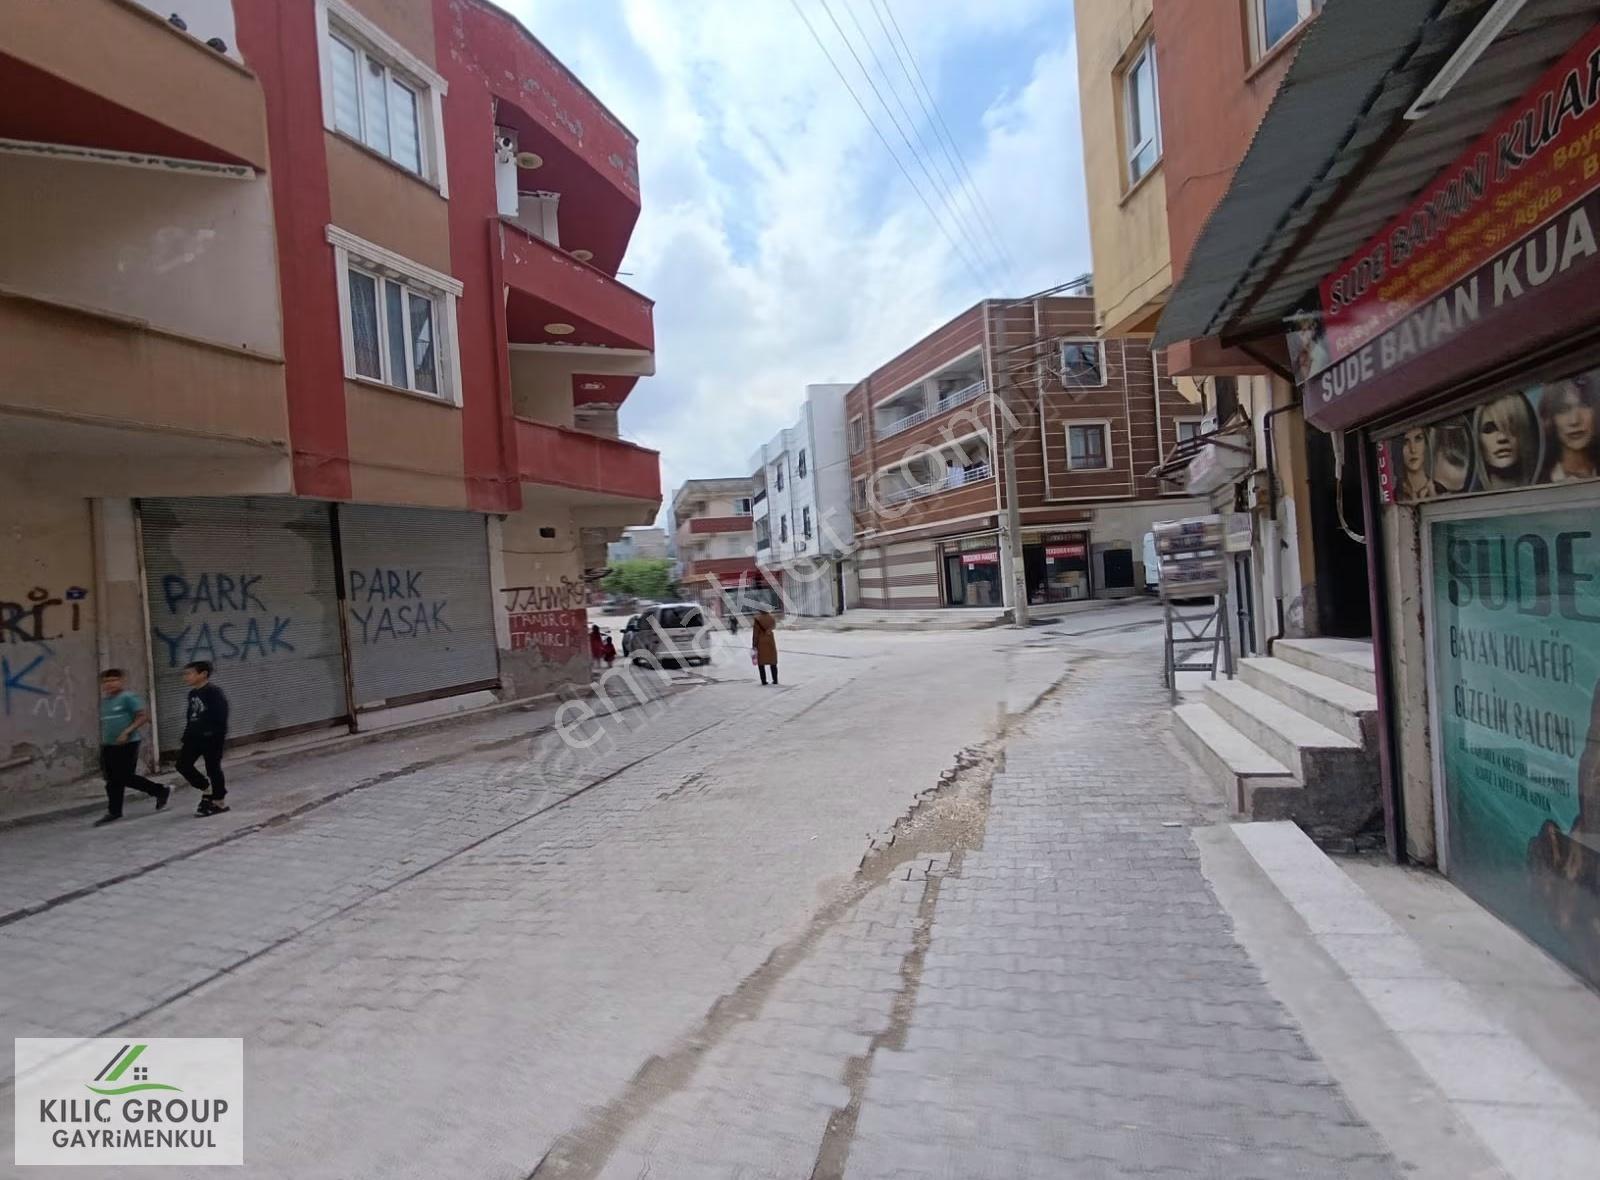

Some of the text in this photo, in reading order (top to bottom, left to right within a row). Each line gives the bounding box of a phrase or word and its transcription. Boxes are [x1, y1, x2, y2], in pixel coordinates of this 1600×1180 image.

[1330, 242, 1386, 315] SUDE
[1389, 153, 1489, 269] BAYAN
[1321, 344, 1375, 403] SUDE
[1380, 275, 1480, 370] BAYAN
[1493, 205, 1598, 309] KUA
[1377, 440, 1391, 503] SUDE
[161, 573, 267, 614] PARK
[350, 567, 423, 602] PARK
[1446, 530, 1600, 622] SUDE
[152, 616, 296, 668] YASAK
[350, 602, 452, 645] YASAK
[1450, 625, 1575, 688] BAYAN KUAFÖR
[1513, 701, 1576, 759] SALONU
